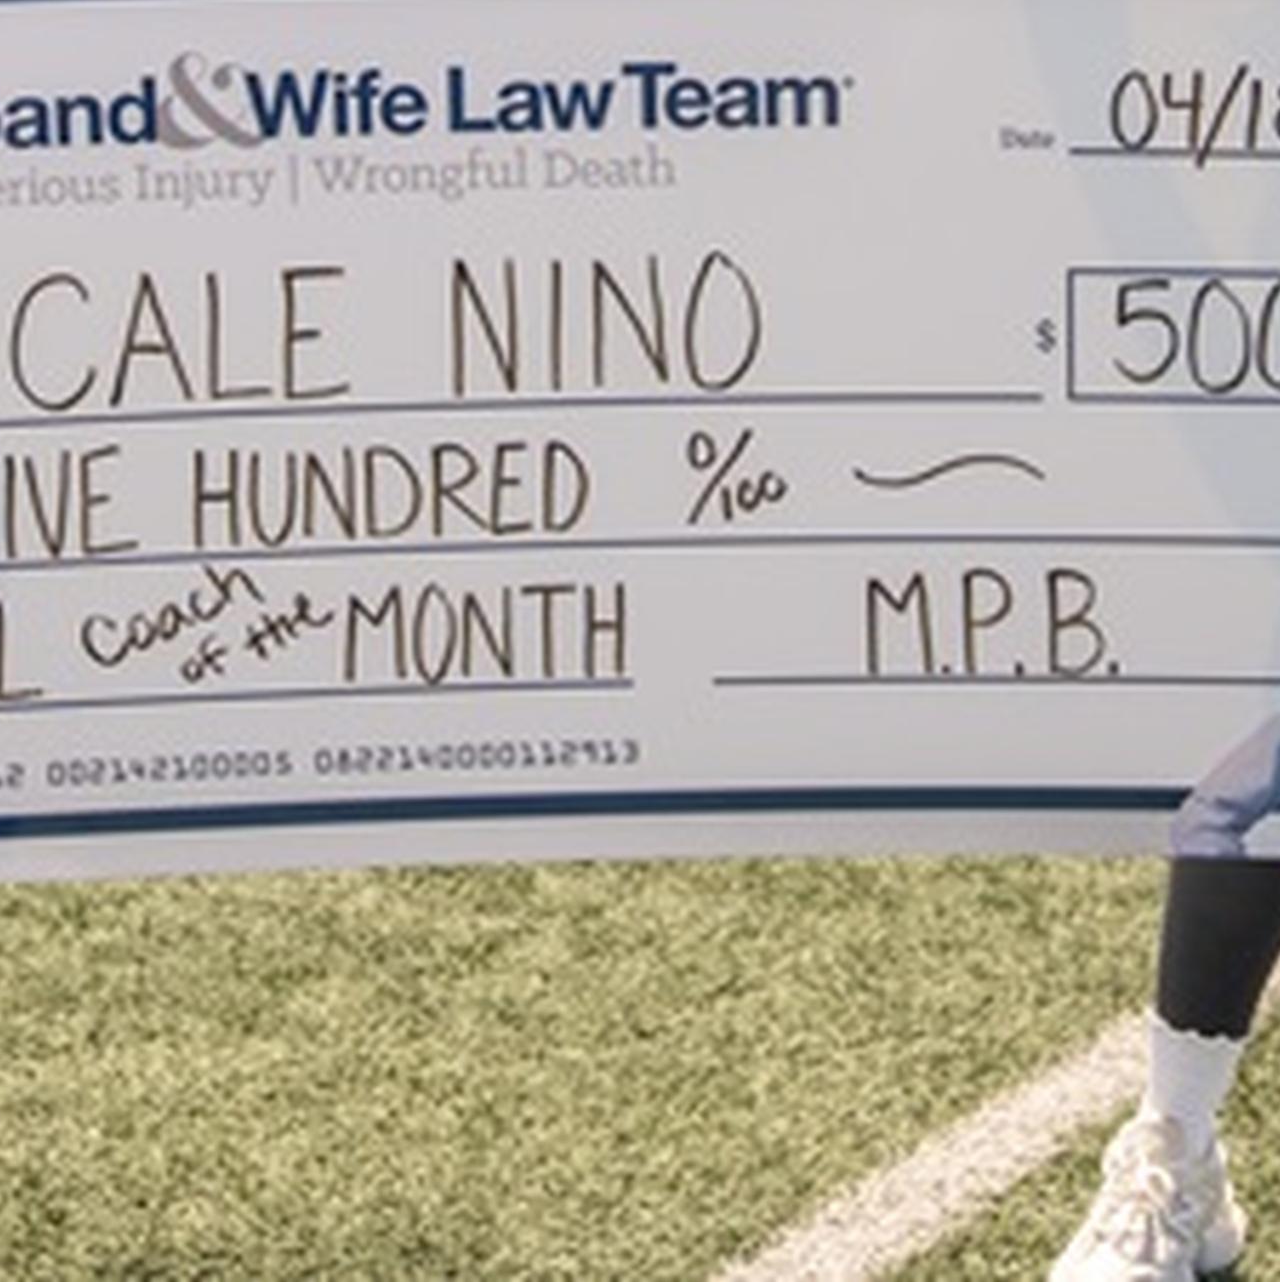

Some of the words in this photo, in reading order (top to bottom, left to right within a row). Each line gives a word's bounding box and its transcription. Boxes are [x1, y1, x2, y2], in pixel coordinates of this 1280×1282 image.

[155, 51, 265, 150] &
[245, 68, 430, 138] Wife
[446, 65, 615, 133] Law
[621, 61, 841, 129] Team
[999, 128, 1056, 150] Date
[136, 160, 273, 208] Injury
[312, 146, 529, 201] Wrongful
[543, 144, 678, 190] Death
[10, 266, 352, 412] CALE
[452, 249, 763, 398] NINO
[193, 439, 590, 549] HUNDRED
[343, 581, 627, 685] MONTH
[865, 567, 1120, 677] M.P.B.
